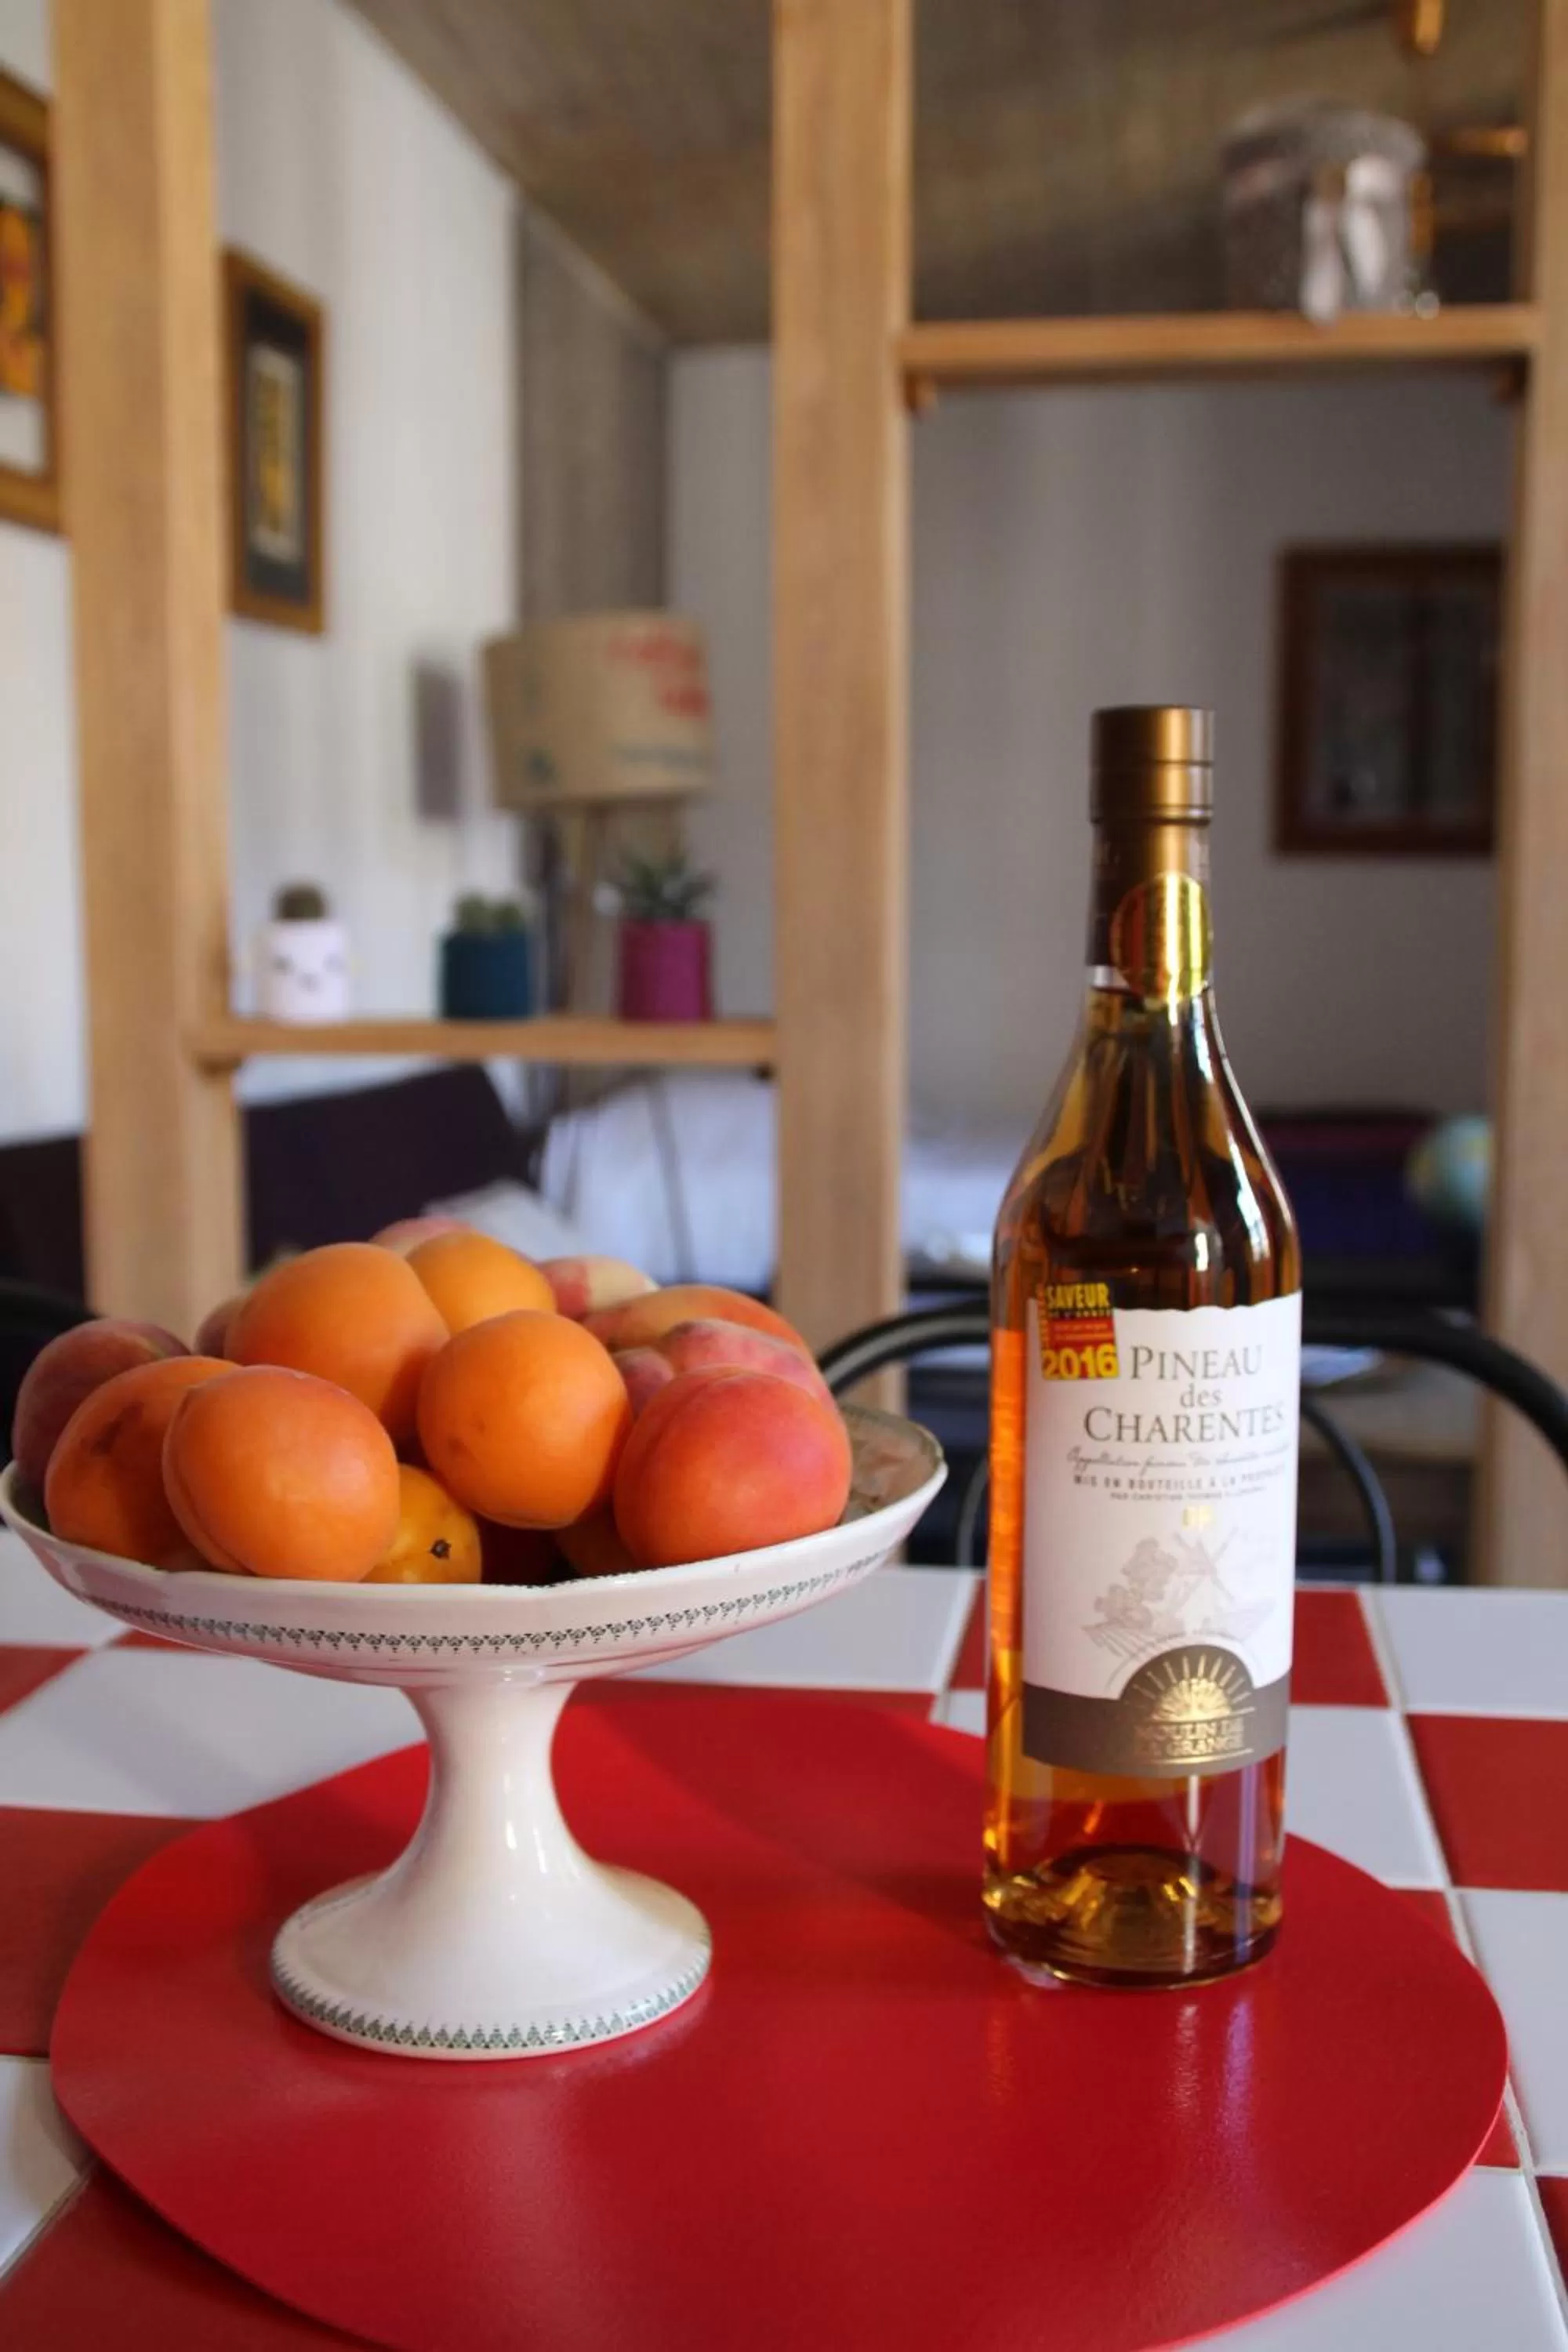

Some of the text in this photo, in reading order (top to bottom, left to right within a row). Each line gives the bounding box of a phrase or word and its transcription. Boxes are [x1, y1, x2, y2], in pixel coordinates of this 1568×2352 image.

[1047, 1283, 1111, 1308] SAVEUR
[1041, 1343, 1120, 1381] 2016
[1129, 1344, 1264, 1381] PINEAU
[1178, 1383, 1224, 1409] des
[1083, 1401, 1286, 1443] CHARENTES
